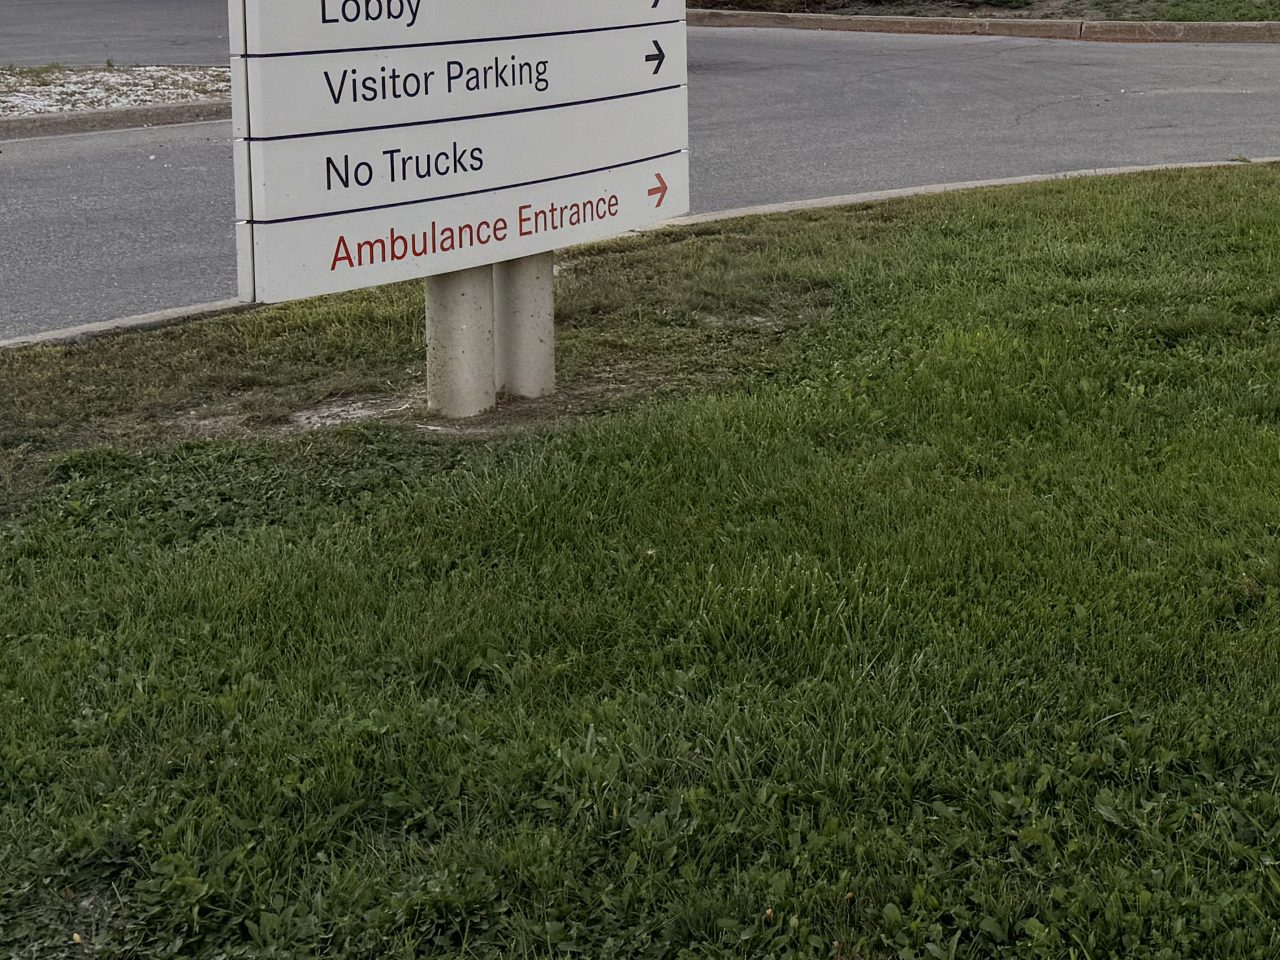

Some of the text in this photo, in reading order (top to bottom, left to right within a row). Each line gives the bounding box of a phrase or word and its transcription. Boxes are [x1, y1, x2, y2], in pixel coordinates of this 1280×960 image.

[324, 55, 548, 104] Visitor Parking
[326, 142, 483, 190] No Trucks
[331, 191, 619, 271] Ambulance Entrance
